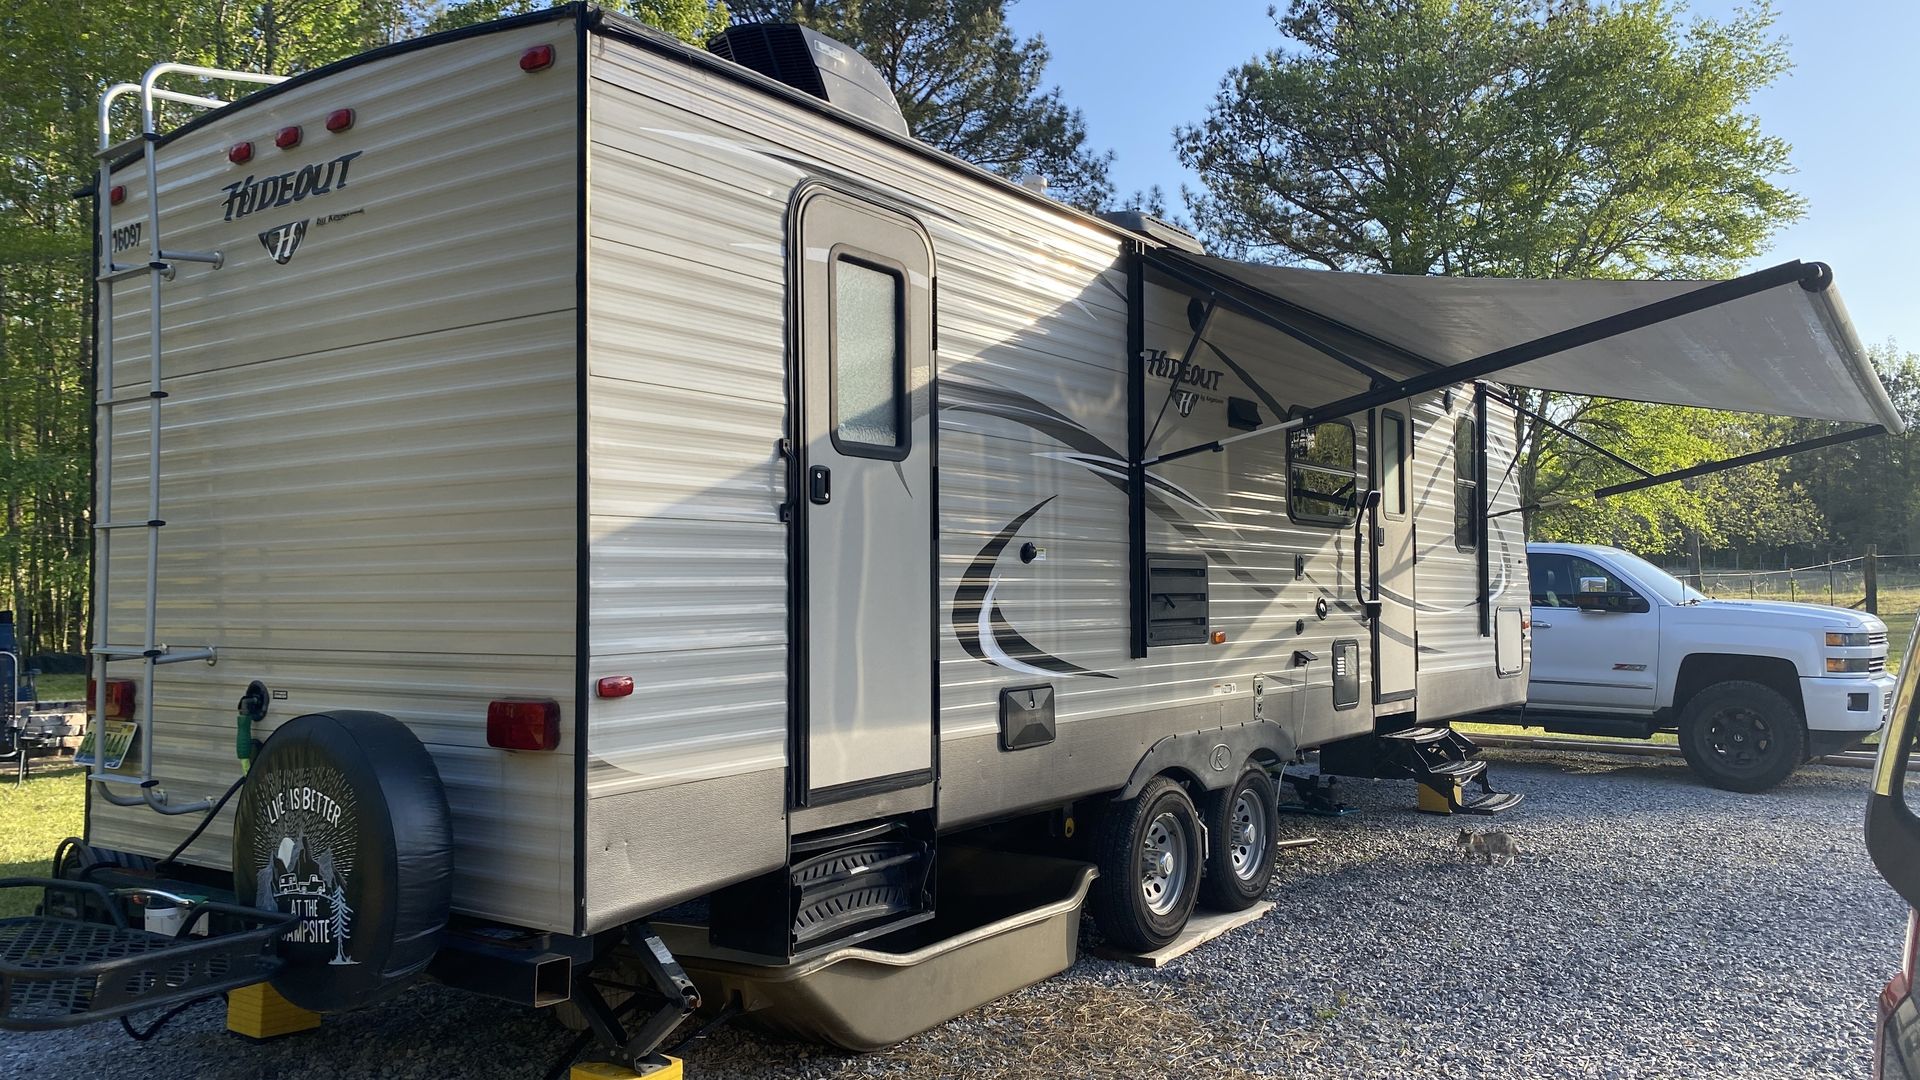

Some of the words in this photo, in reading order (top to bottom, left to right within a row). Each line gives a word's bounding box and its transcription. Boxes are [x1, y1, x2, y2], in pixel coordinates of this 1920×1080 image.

[221, 150, 363, 221] HIDEOUT
[1145, 348, 1224, 391] HIDEOUT
[267, 792, 286, 825] LIFE
[289, 787, 300, 811] IS
[302, 786, 342, 829] BETTER
[290, 899, 302, 917] AT
[303, 899, 319, 918] THE
